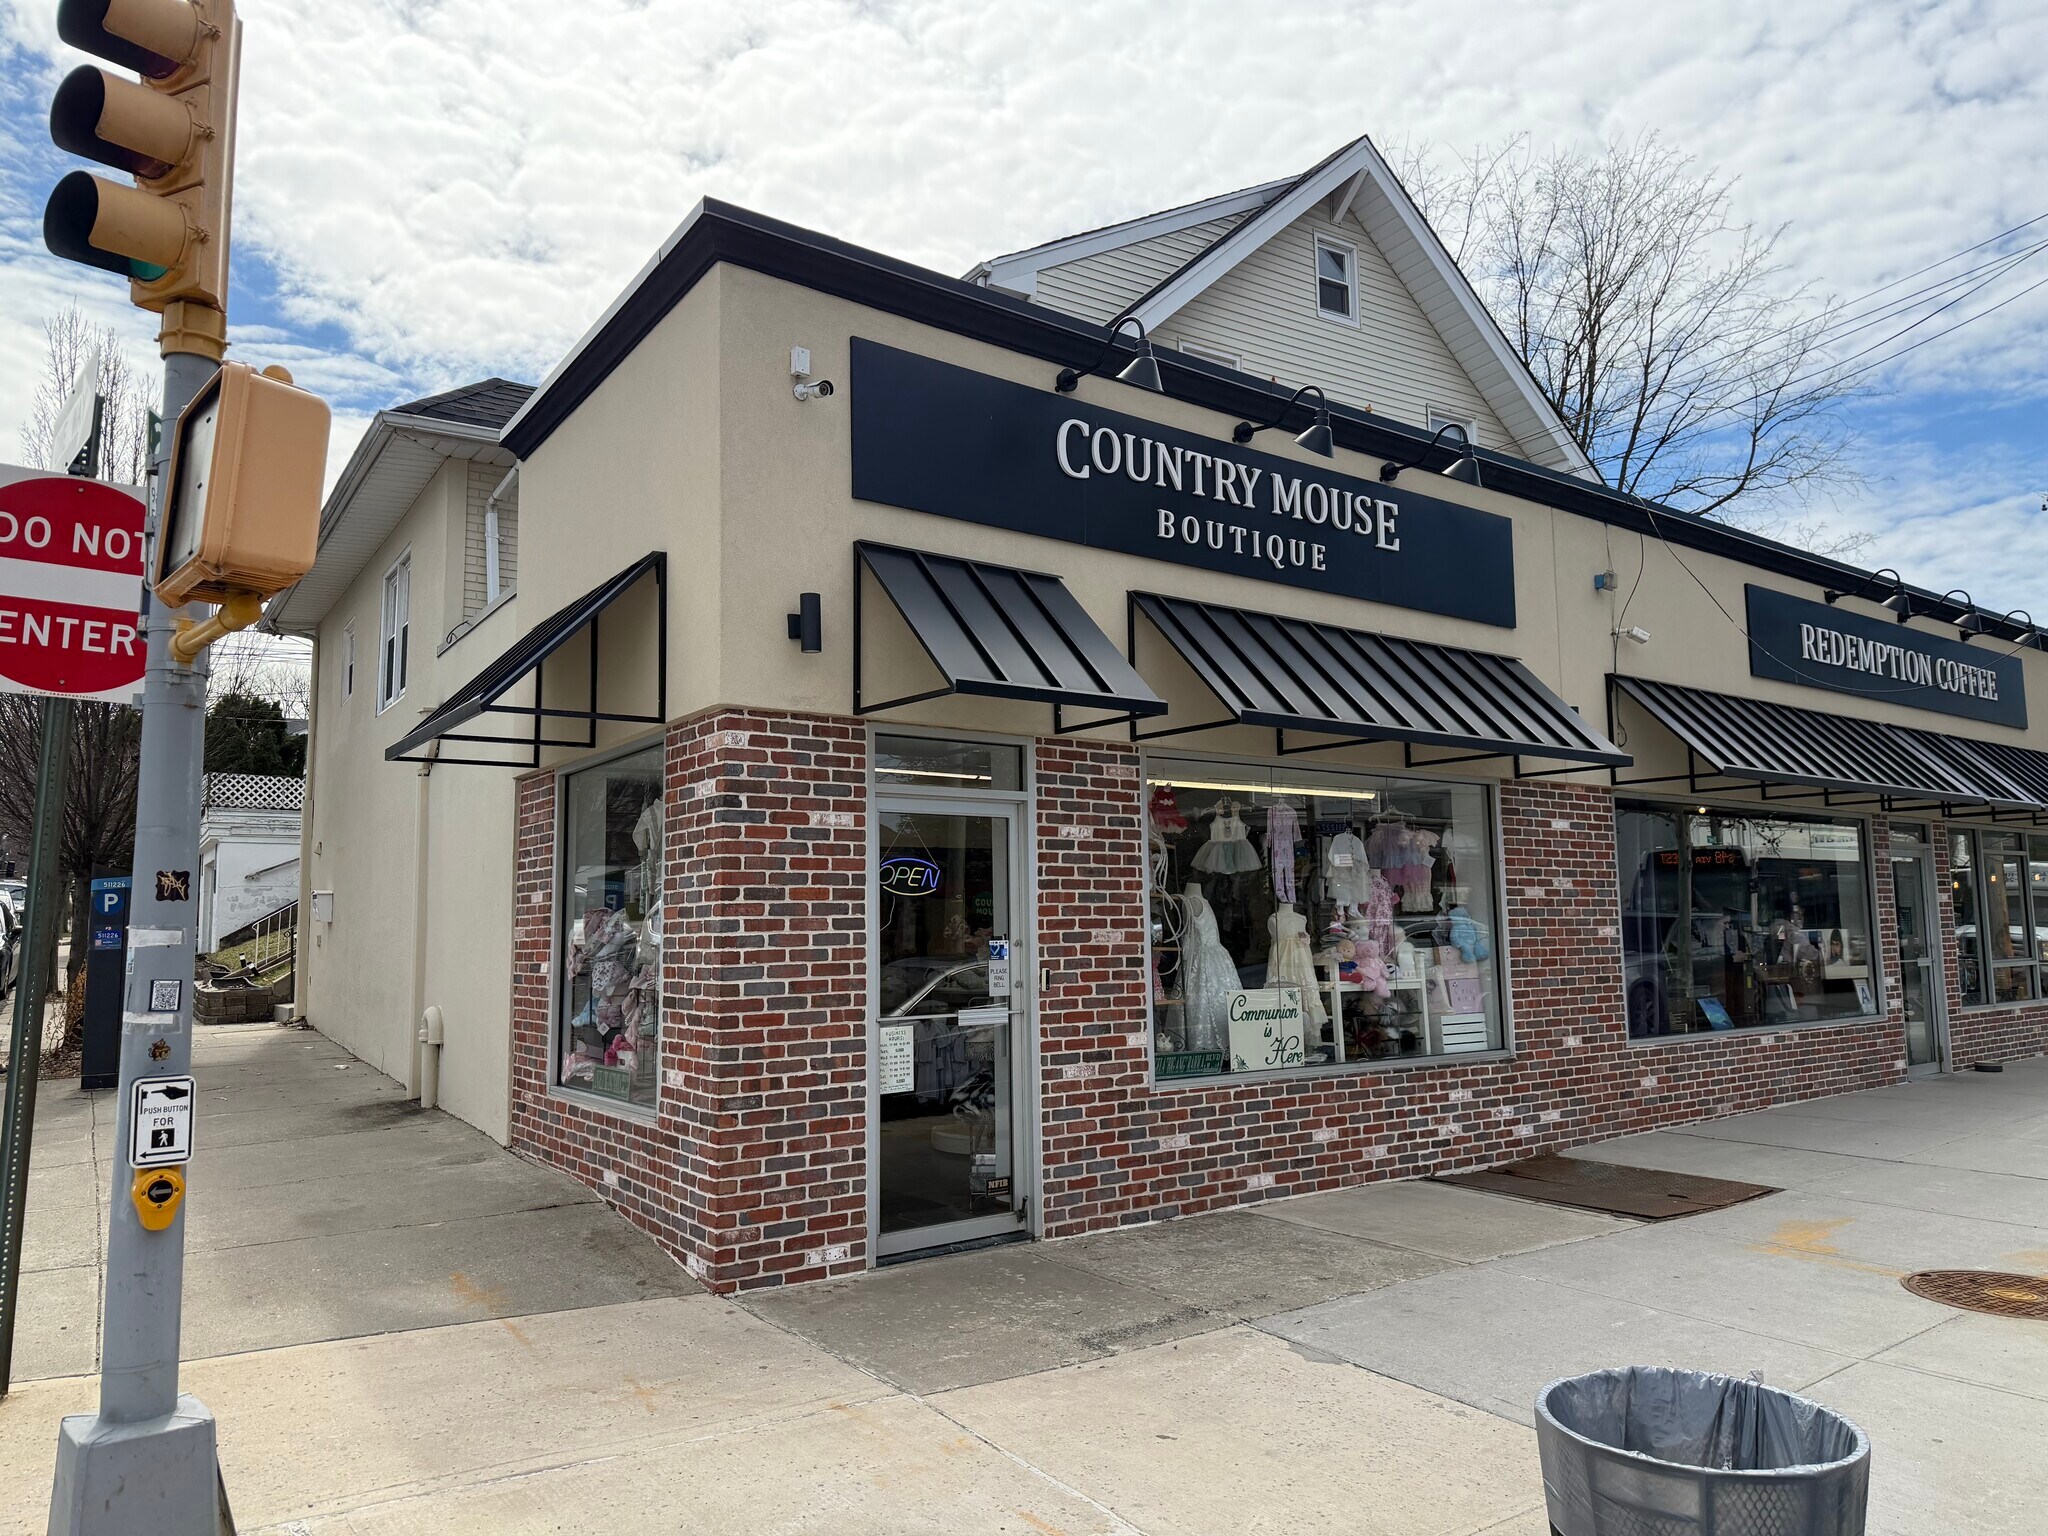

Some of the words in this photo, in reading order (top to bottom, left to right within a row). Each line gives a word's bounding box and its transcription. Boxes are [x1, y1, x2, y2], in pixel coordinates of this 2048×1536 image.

[1057, 420, 1263, 508] COUNTRY
[1271, 473, 1399, 552] MOUSE
[0, 511, 51, 548] DO
[72, 522, 146, 563] NOT
[1157, 508, 1327, 573] BOUTIQUE
[0, 609, 136, 656] ENTER
[1801, 624, 1932, 686] REDEMPTION
[1935, 658, 1998, 701] COFFEE
[879, 865, 940, 888] OPEN
[104, 893, 119, 912] P
[975, 898, 992, 907] COU
[990, 967, 1008, 975] PLEASE
[1230, 994, 1299, 1022] Communion
[1264, 1022, 1272, 1037] is
[1265, 1035, 1303, 1065] Here
[143, 1106, 162, 1115] PUSH
[163, 1104, 189, 1113] BUTTON
[153, 1116, 174, 1127] FOR
[988, 1179, 1008, 1189] NFIB
